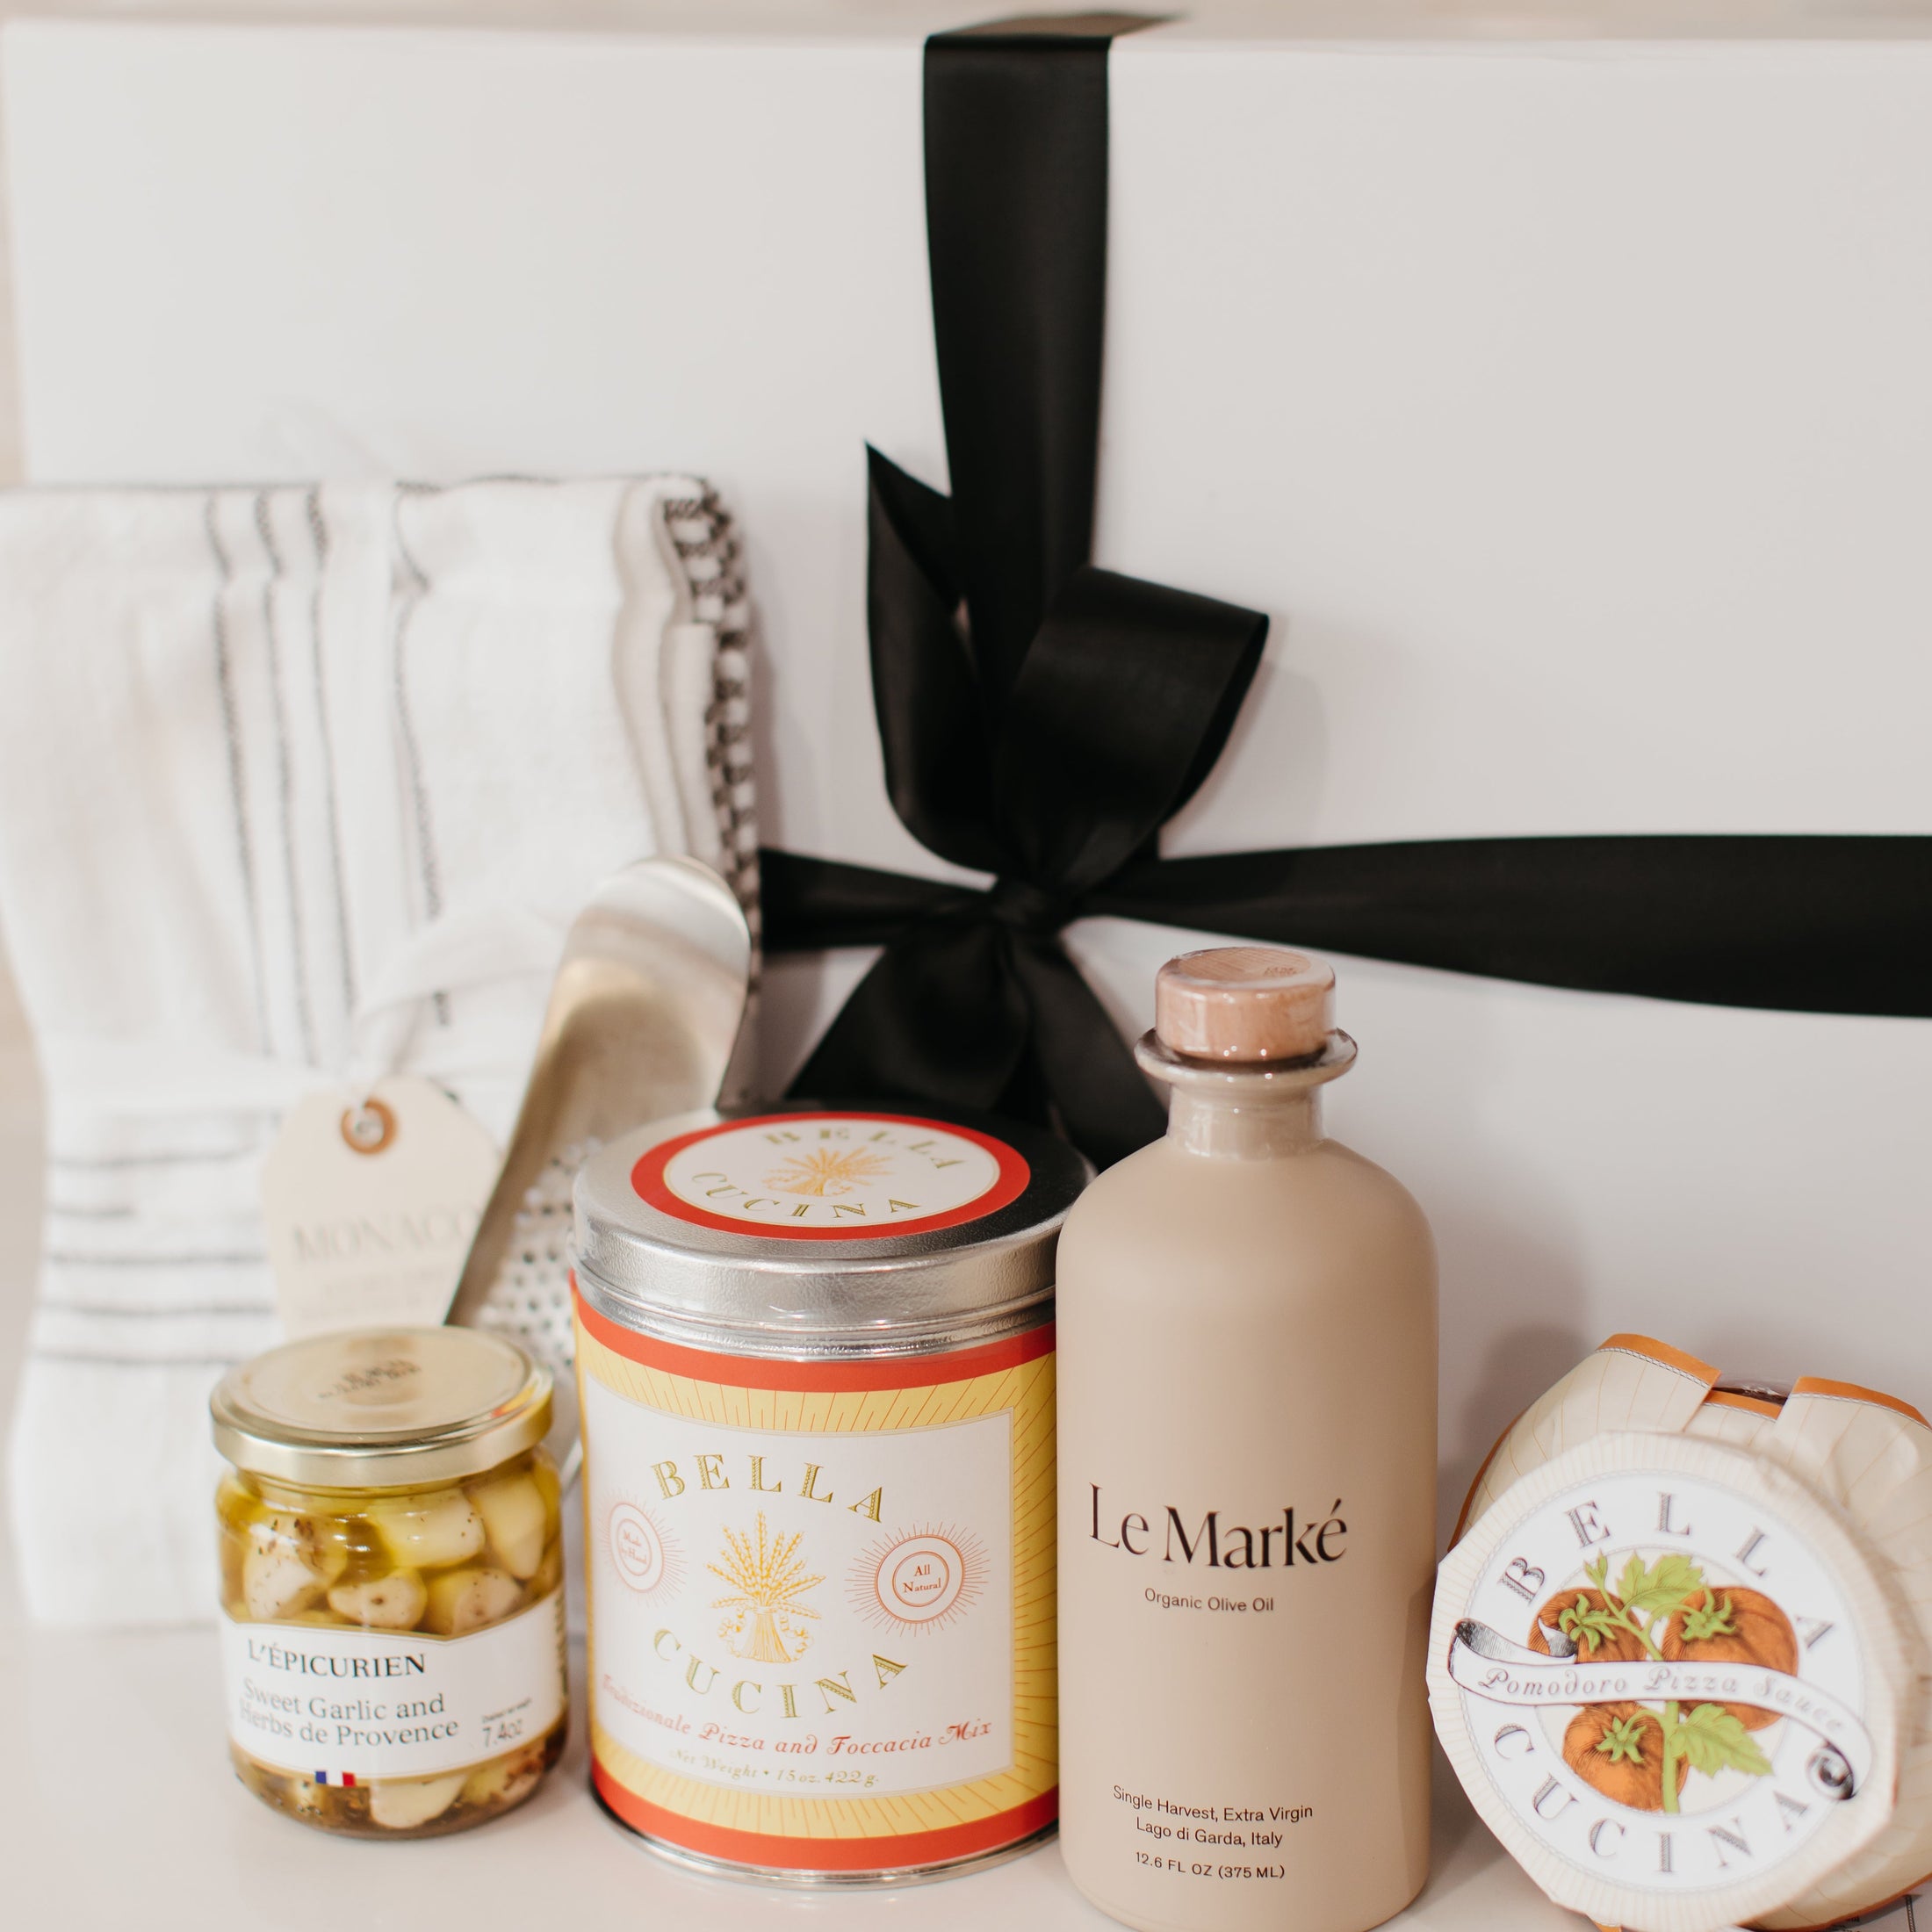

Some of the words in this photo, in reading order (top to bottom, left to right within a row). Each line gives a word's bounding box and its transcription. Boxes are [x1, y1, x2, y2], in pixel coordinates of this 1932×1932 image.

[764, 1128, 965, 1171] BELLA
[692, 1172, 920, 1219] CUCINA
[650, 1453, 885, 1523] BELLA
[1089, 1482, 1150, 1555] Le
[1161, 1497, 1348, 1569] Marké
[903, 1577, 941, 1593] Natural
[913, 1564, 931, 1577] All
[1497, 1492, 1835, 1651] BELLA
[1144, 1587, 1202, 1609] Organic
[1208, 1597, 1247, 1611] Olive
[1252, 1597, 1274, 1612] Oil
[653, 1628, 908, 1719] CUCINA
[243, 1677, 301, 1715] Sweet
[309, 1695, 387, 1720] Garlic
[396, 1692, 446, 1719] and
[1478, 1668, 1628, 1697] Pomodoro
[1644, 1667, 1737, 1694] Pizza
[1755, 1676, 1845, 1733] Sauce
[240, 1700, 293, 1738] Herbs
[299, 1720, 329, 1745] de
[336, 1719, 459, 1747] Provence
[698, 1722, 766, 1750] Pizza
[775, 1734, 818, 1755] and
[827, 1730, 932, 1755] Foccacia
[938, 1719, 992, 1745] Mix
[669, 1748, 696, 1764] Net
[703, 1756, 757, 1780] Weight
[825, 1769, 861, 1784] 422
[1114, 1785, 1153, 1809] Single
[1157, 1799, 1219, 1822] Harvest,
[1224, 1807, 1265, 1822] Extra
[1269, 1805, 1313, 1823] Virgin
[1494, 1723, 1809, 1873] CUCINA
[1136, 1816, 1171, 1839] Lago
[1177, 1827, 1190, 1841] di
[1195, 1828, 1246, 1848] Garda,
[1251, 1831, 1283, 1849] Italy
[1135, 1851, 1163, 1869] 12.6
[1168, 1859, 1186, 1873] FL
[1192, 1864, 1213, 1877] OZ
[1218, 1866, 1252, 1879] (375
[1257, 1865, 1285, 1879] ML)
